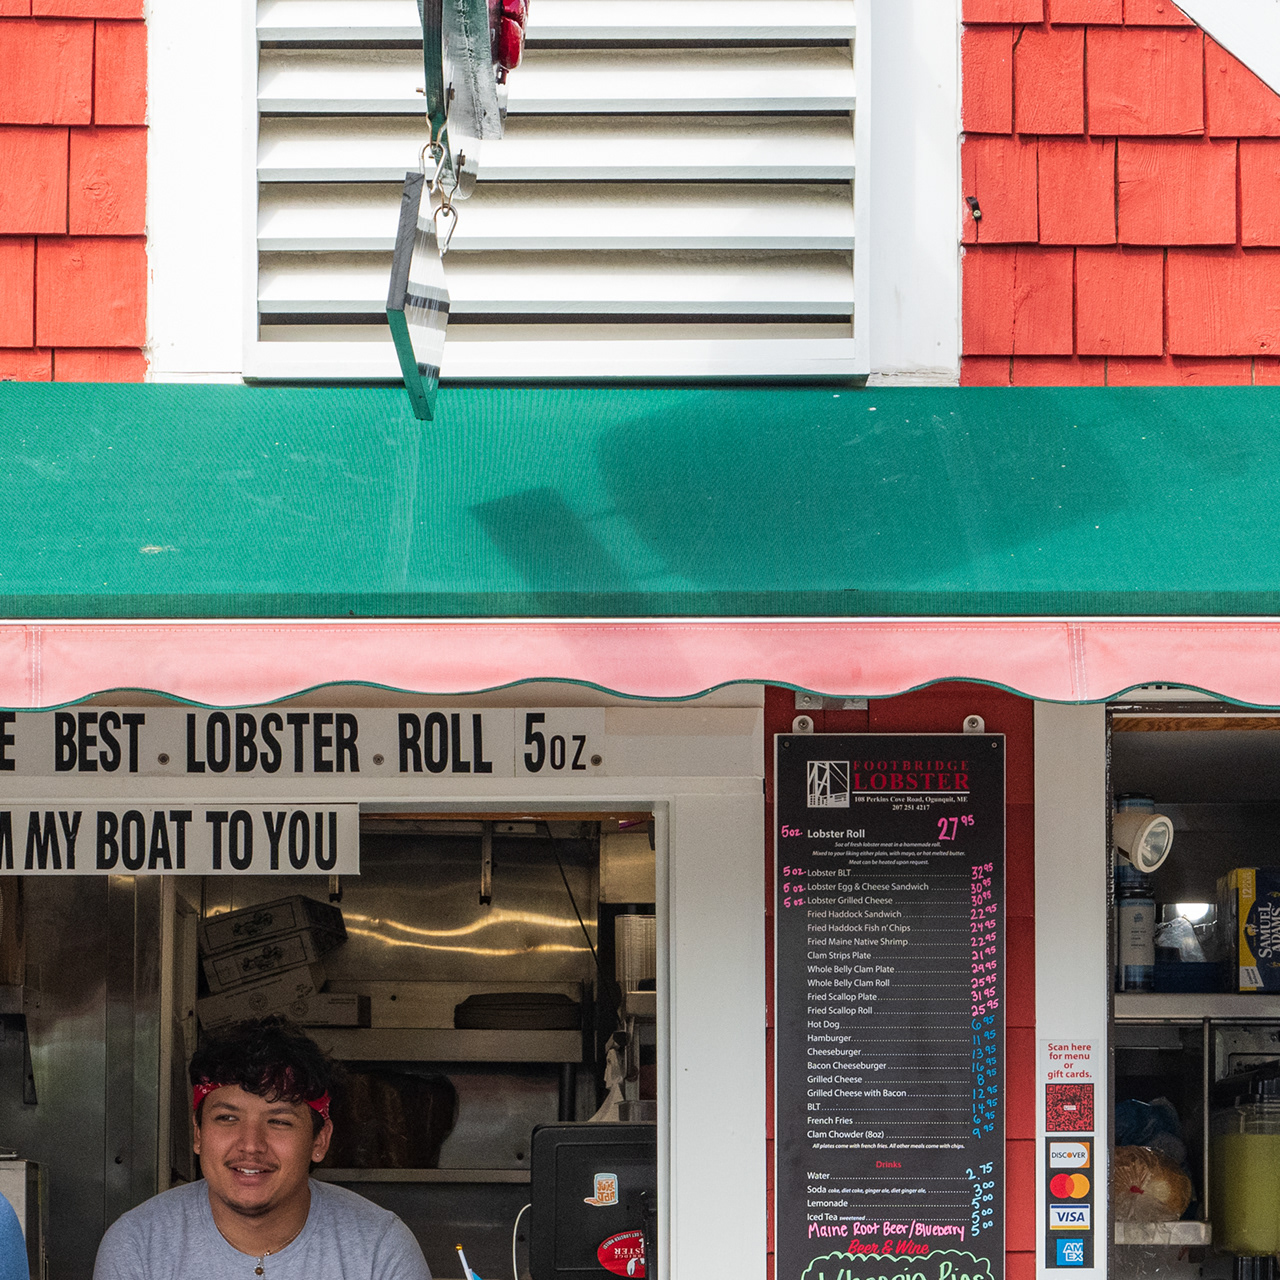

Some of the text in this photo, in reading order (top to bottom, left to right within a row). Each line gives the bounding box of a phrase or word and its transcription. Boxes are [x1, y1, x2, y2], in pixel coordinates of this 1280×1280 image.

[55, 711, 146, 772] BEST
[187, 712, 359, 773] LOBSTER
[399, 712, 492, 773] ROLL
[854, 760, 968, 771] FOOTBRIDGE
[854, 773, 969, 790] LOBSTER
[807, 829, 865, 838] Lobster Roll
[24, 812, 82, 870] MY
[96, 811, 192, 870] BOAT
[206, 811, 253, 870] TO
[263, 811, 337, 870] YOU
[807, 910, 902, 918] Fried Haddock Sandwich
[1258, 902, 1272, 957] SAMUEL
[880, 938, 908, 947] Shrimp
[807, 965, 895, 975] Whole Belly Clam Plate
[824, 1020, 840, 1030] Dog
[807, 1034, 851, 1044] Hamburger
[1048, 1043, 1091, 1051] Scan here
[807, 1048, 861, 1057] Cheeseburger
[1049, 1052, 1062, 1060] for
[807, 1061, 886, 1071] Bacon Cheeseburger
[807, 1075, 862, 1083] Grilled Cheese
[1047, 1070, 1092, 1079] gift cards.
[807, 1103, 821, 1111] BLT
[807, 1130, 884, 1139] Clam Chowder (8oz)
[807, 1185, 827, 1193] Soda
[807, 1199, 848, 1207] Lemonade
[807, 1213, 838, 1221] Iced Tea
[1057, 1212, 1085, 1222] VISA
[808, 1222, 848, 1238] Maine
[854, 1224, 880, 1234] Root
[848, 1239, 929, 1254] Beer & Wine
[1063, 1243, 1083, 1251] AM
[1066, 1252, 1083, 1261] EX
